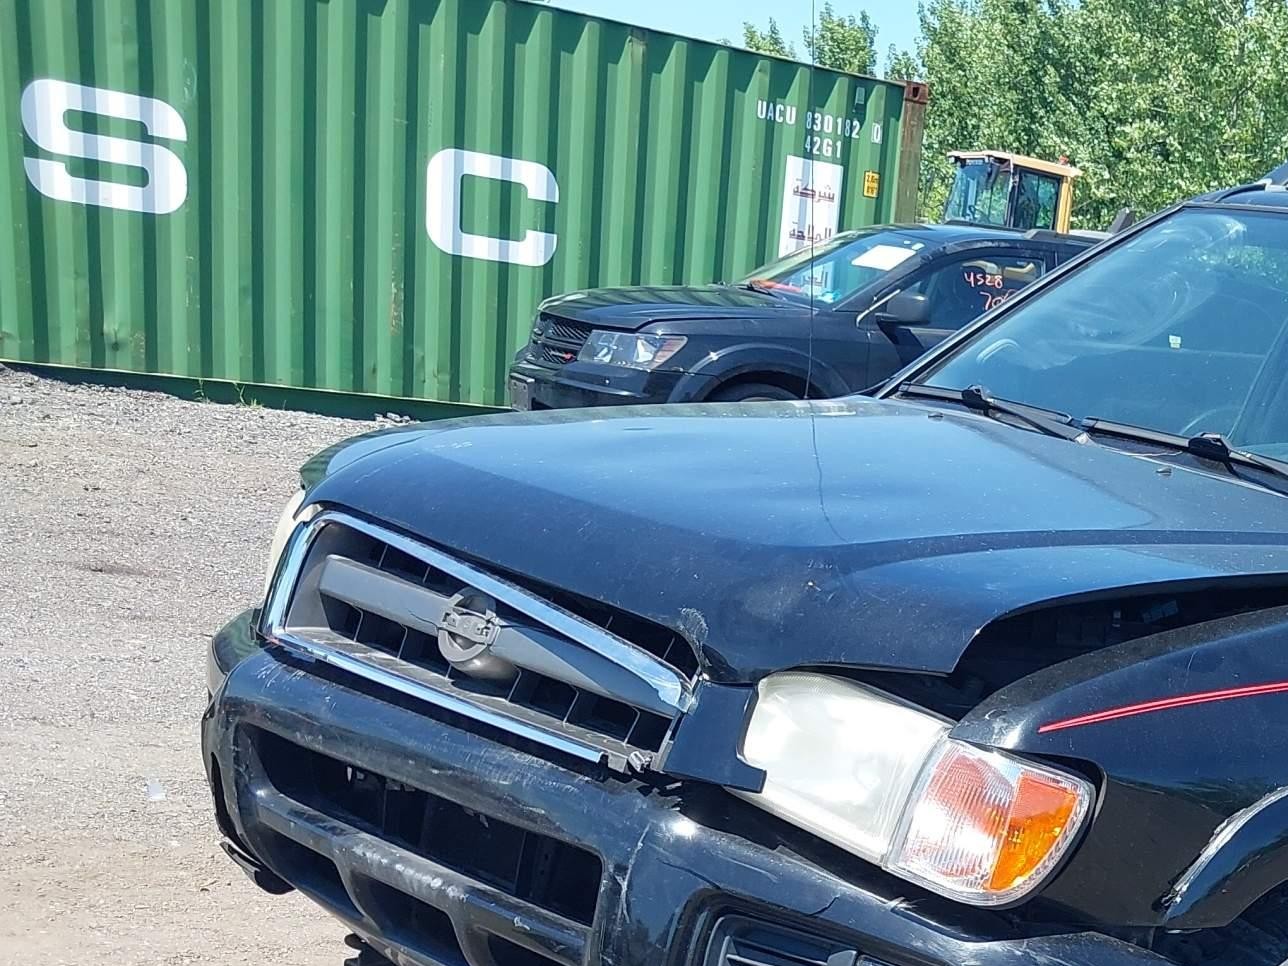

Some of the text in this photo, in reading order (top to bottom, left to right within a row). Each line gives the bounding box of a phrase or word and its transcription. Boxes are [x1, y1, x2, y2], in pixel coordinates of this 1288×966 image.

[757, 100, 797, 125] UACU
[806, 111, 860, 139] 830182
[805, 135, 841, 158] 42G1
[21, 79, 559, 267] S C
[963, 272, 1003, 288] 4528
